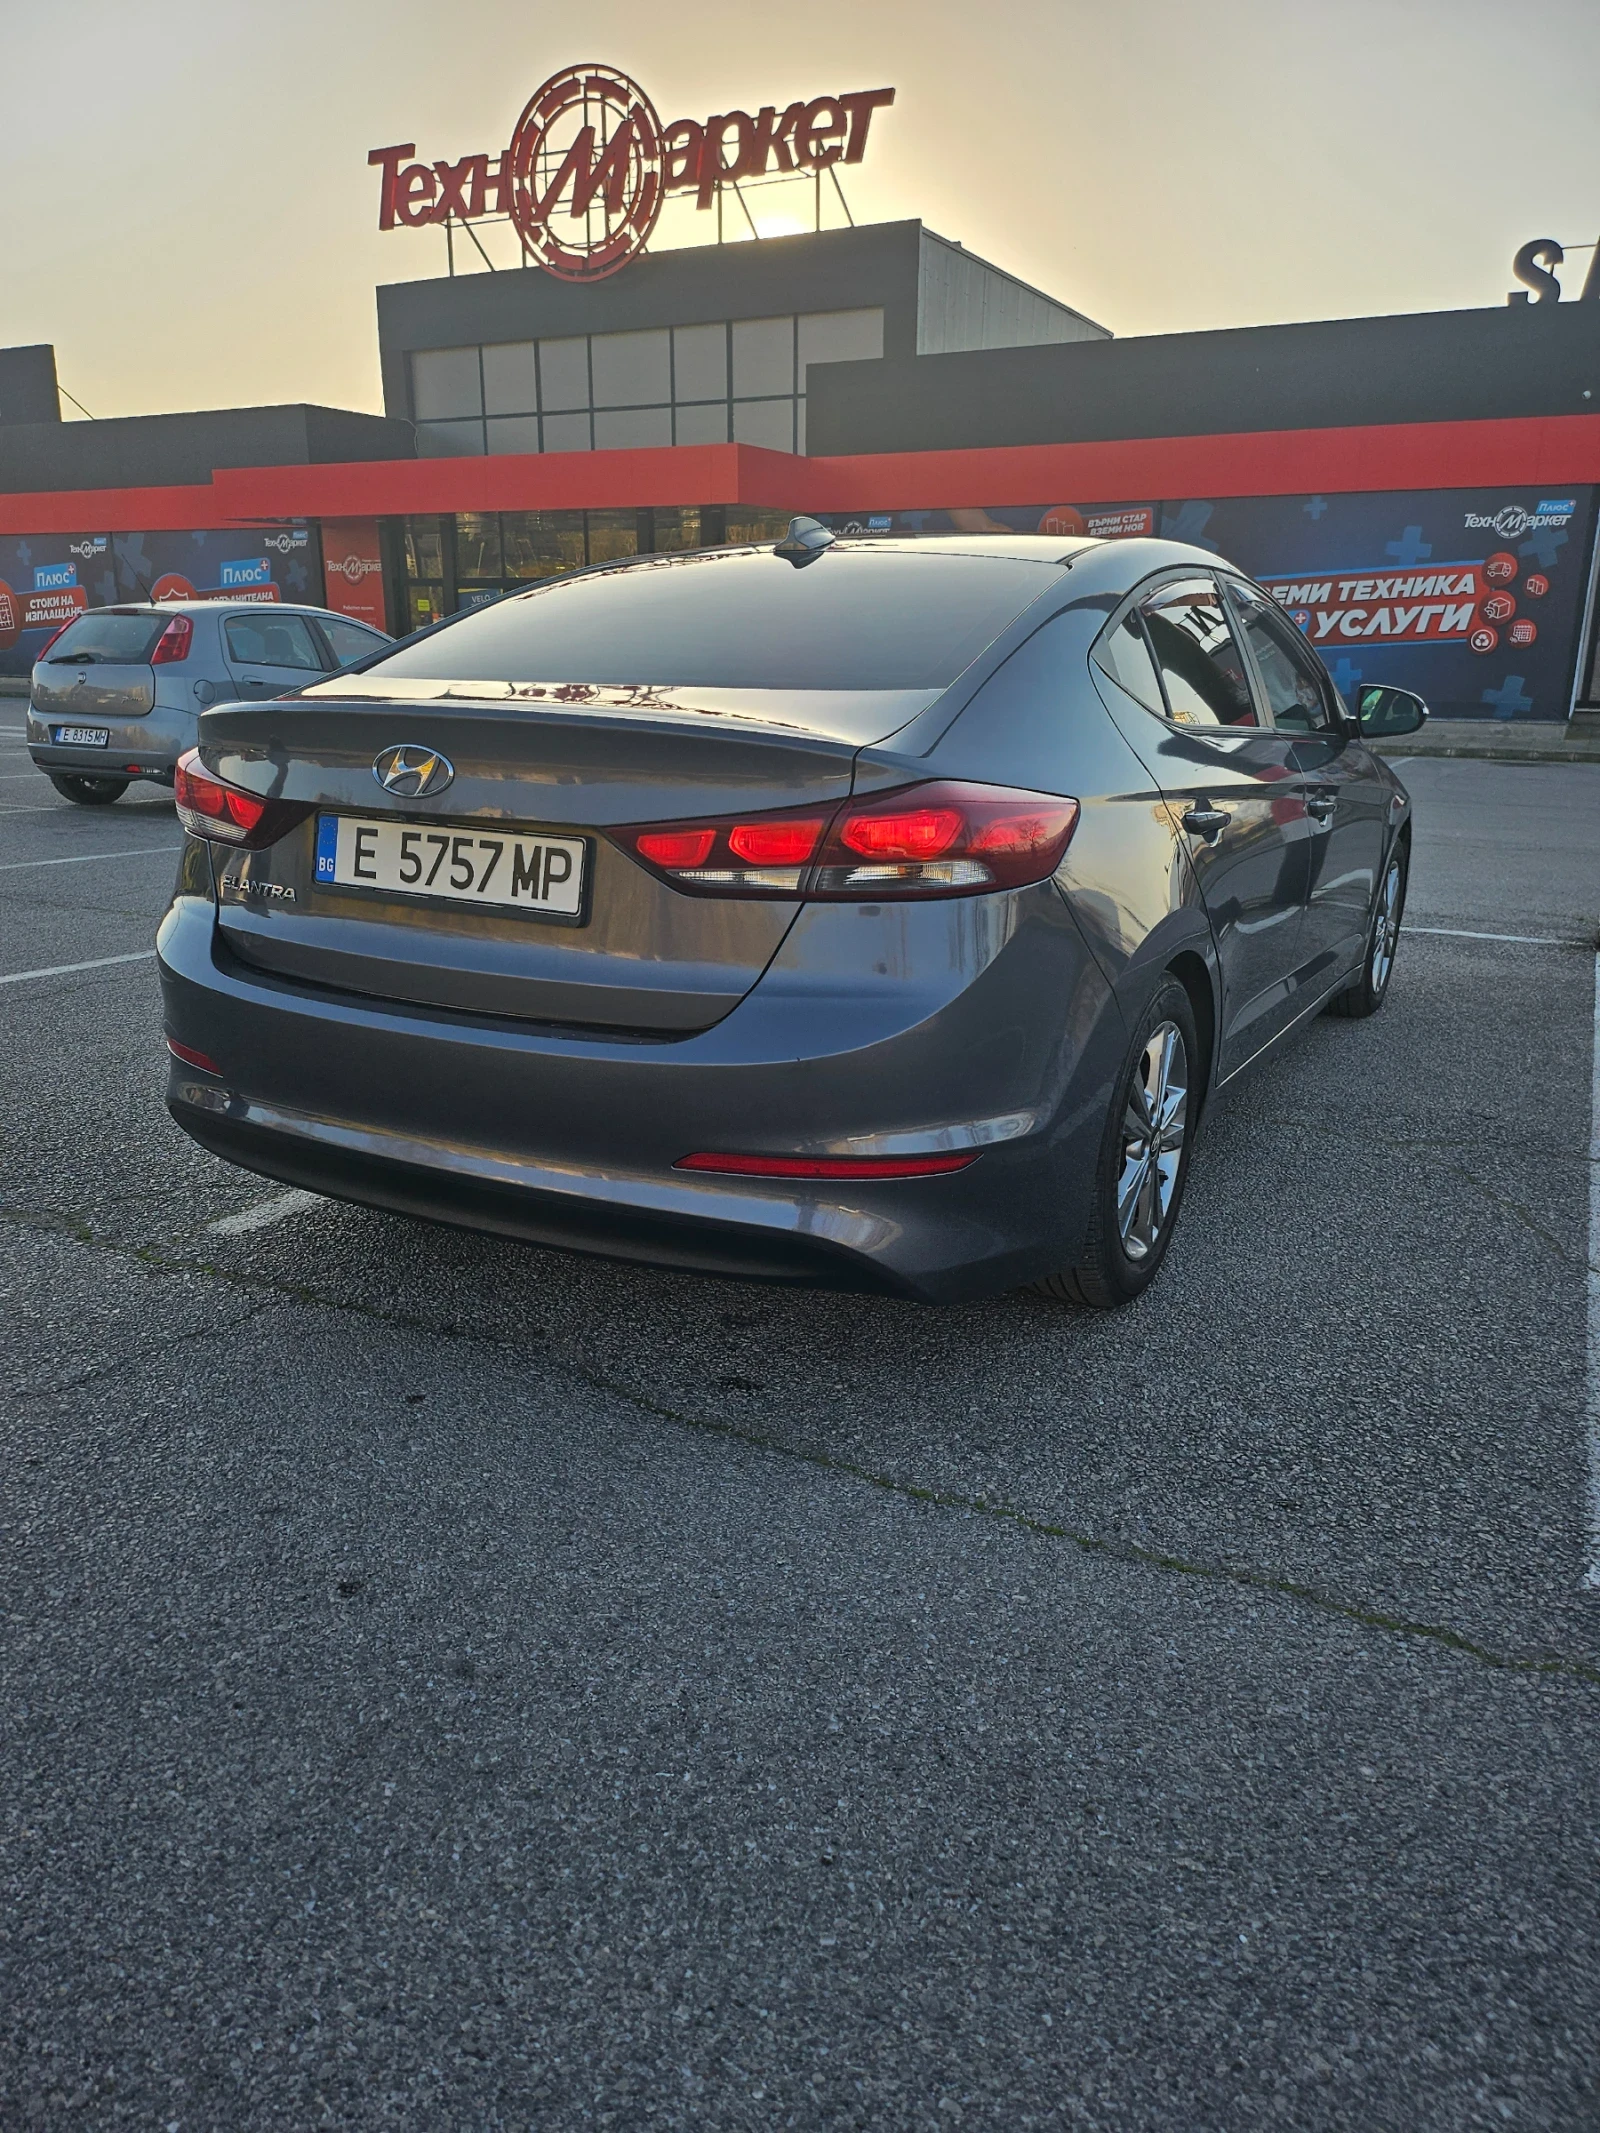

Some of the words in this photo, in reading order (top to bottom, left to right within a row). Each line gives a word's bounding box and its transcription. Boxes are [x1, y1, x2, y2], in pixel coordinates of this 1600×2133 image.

[1508, 238, 1600, 307] S
[1087, 517, 1121, 528] ВЪРНИ
[1122, 514, 1147, 523] СТАР
[1090, 526, 1123, 536] ВЗЕМИ
[1123, 522, 1145, 532] НОВ
[1268, 582, 1332, 606] ЕМИ
[1337, 573, 1475, 602] ТЕХНИКА
[30, 597, 60, 609] СТОКИ
[61, 595, 74, 606] НА
[1313, 603, 1476, 638] УСЛУГИ
[63, 728, 69, 740] E
[73, 729, 93, 742] 8315
[318, 856, 334, 872] BG
[353, 826, 379, 879] E
[399, 831, 503, 893] 5757
[510, 843, 574, 901] MP
[222, 874, 298, 901] ELANTRA
